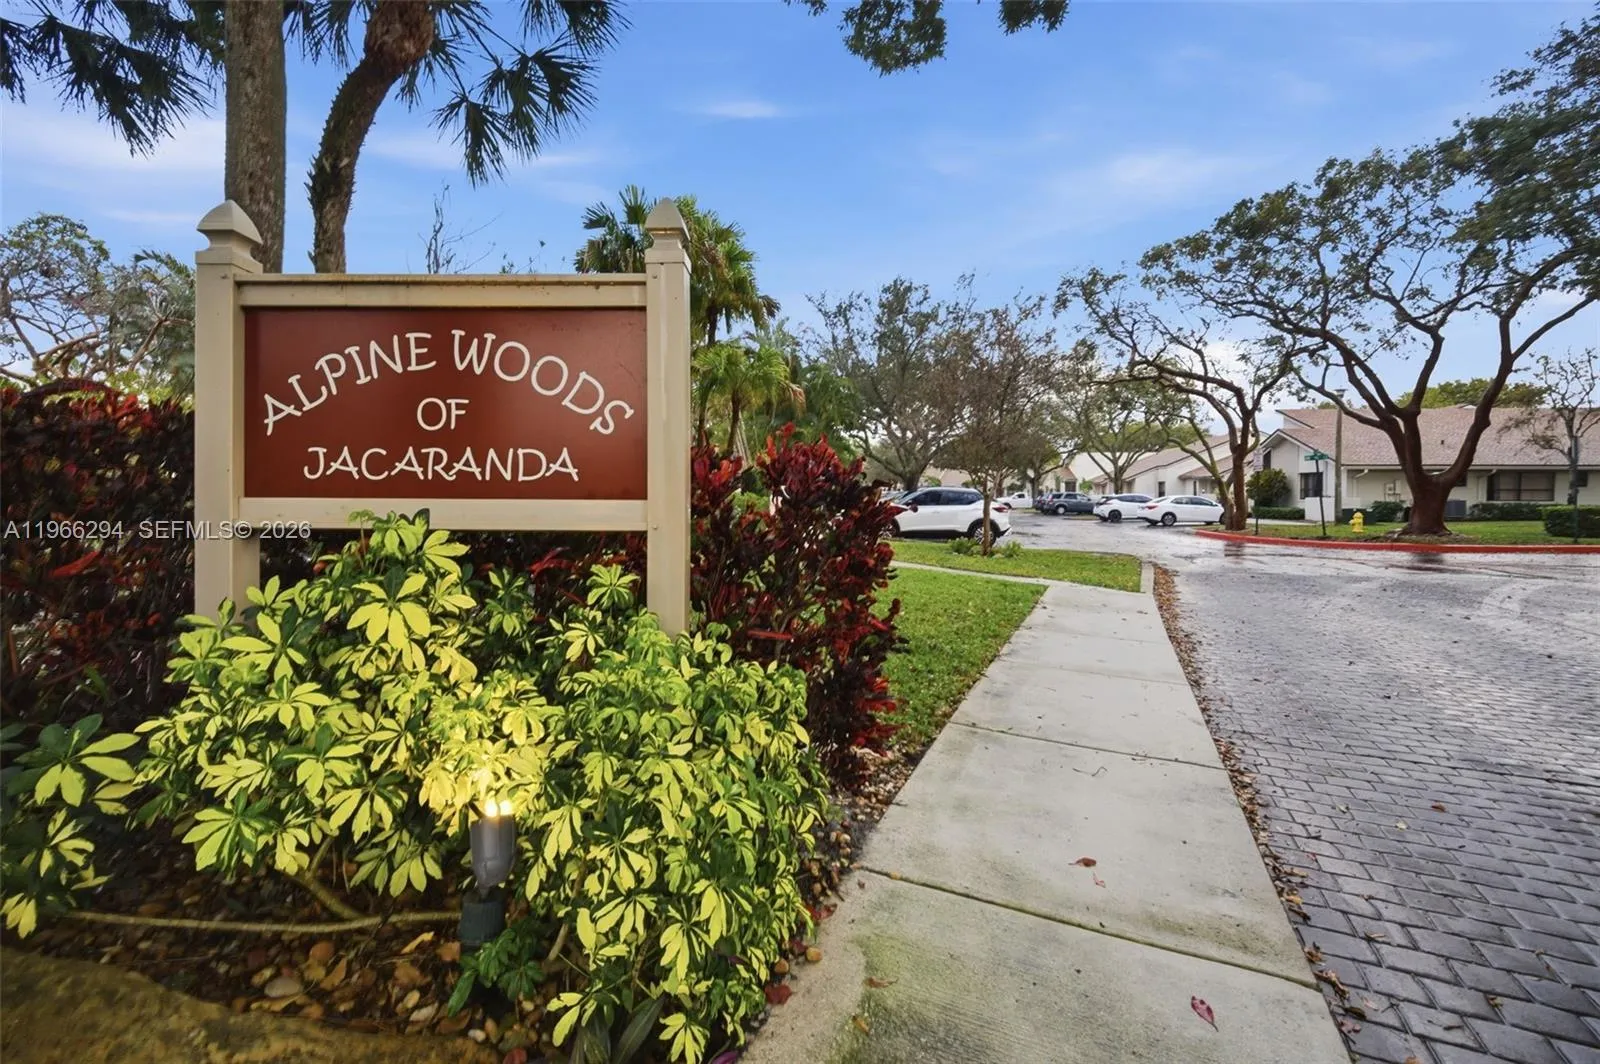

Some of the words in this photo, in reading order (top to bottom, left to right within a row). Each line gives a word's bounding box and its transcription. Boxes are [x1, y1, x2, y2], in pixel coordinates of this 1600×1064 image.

[264, 331, 437, 435] ALPINE
[452, 329, 633, 435] WOODS
[416, 397, 469, 431] OF
[304, 446, 579, 482] JACARANDA
